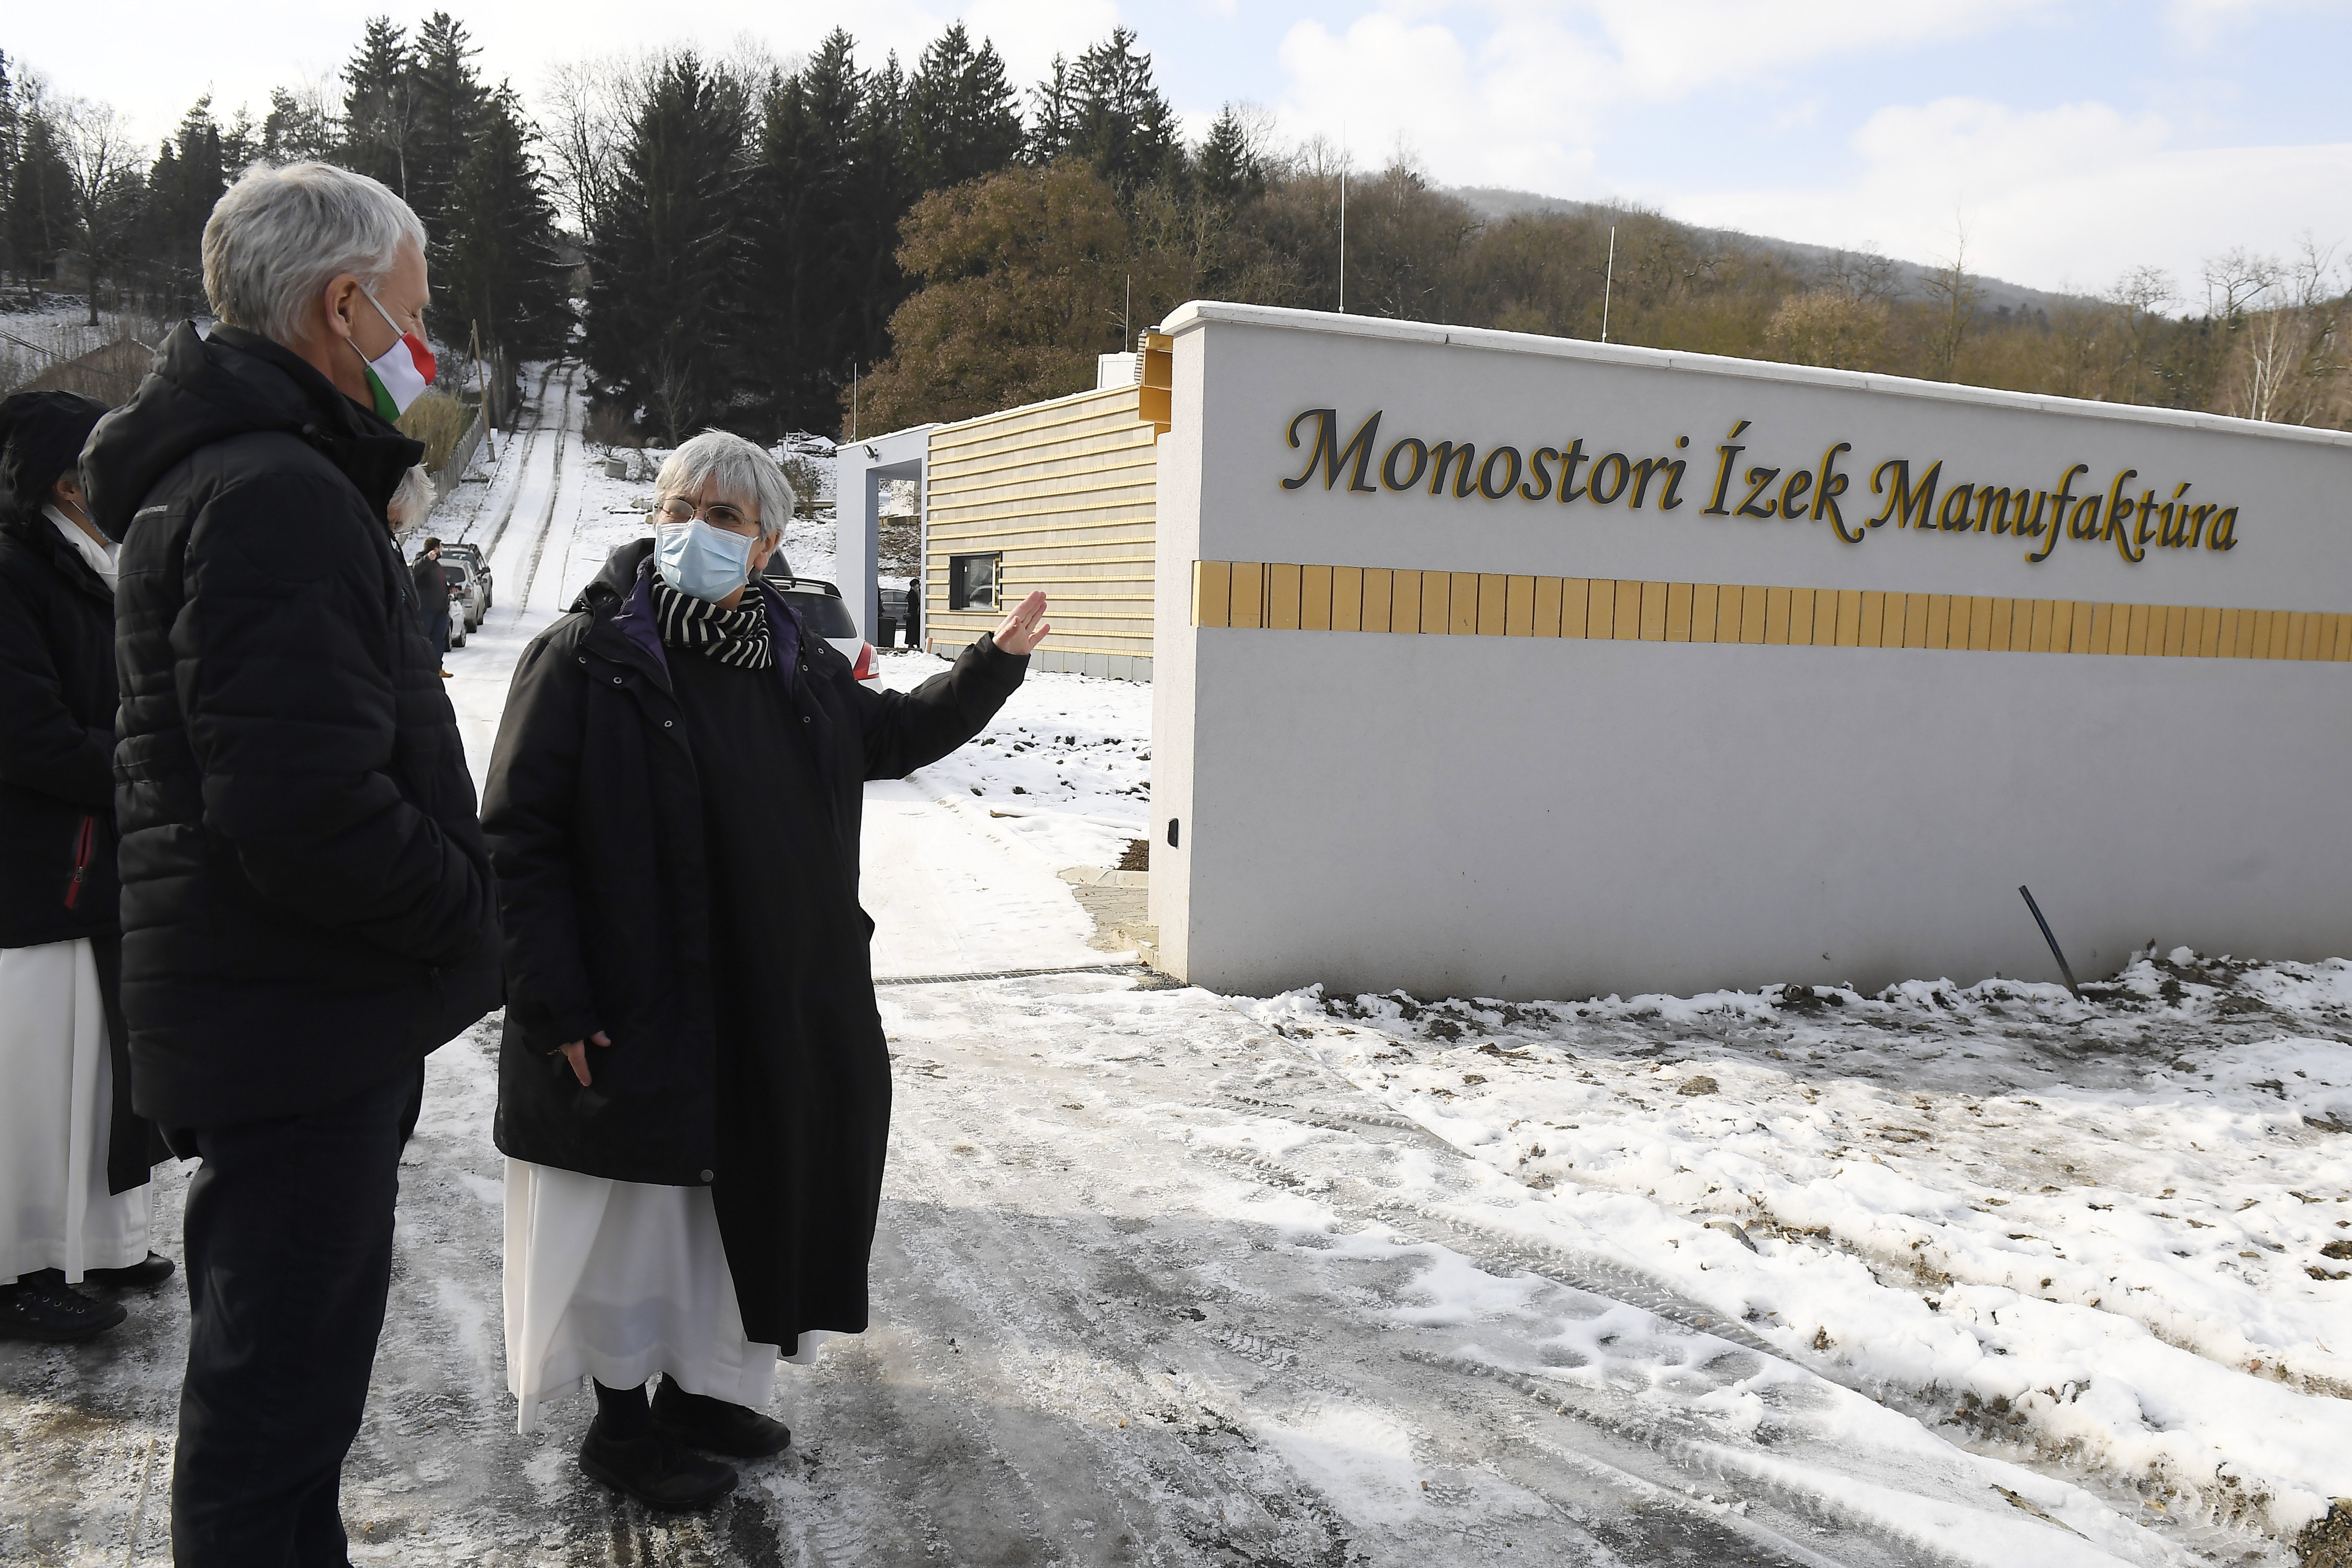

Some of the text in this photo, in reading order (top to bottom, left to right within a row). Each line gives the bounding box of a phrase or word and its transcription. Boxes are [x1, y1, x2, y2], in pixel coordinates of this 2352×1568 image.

[1280, 408, 2239, 564] Monostori Ízek Manufaktúra
